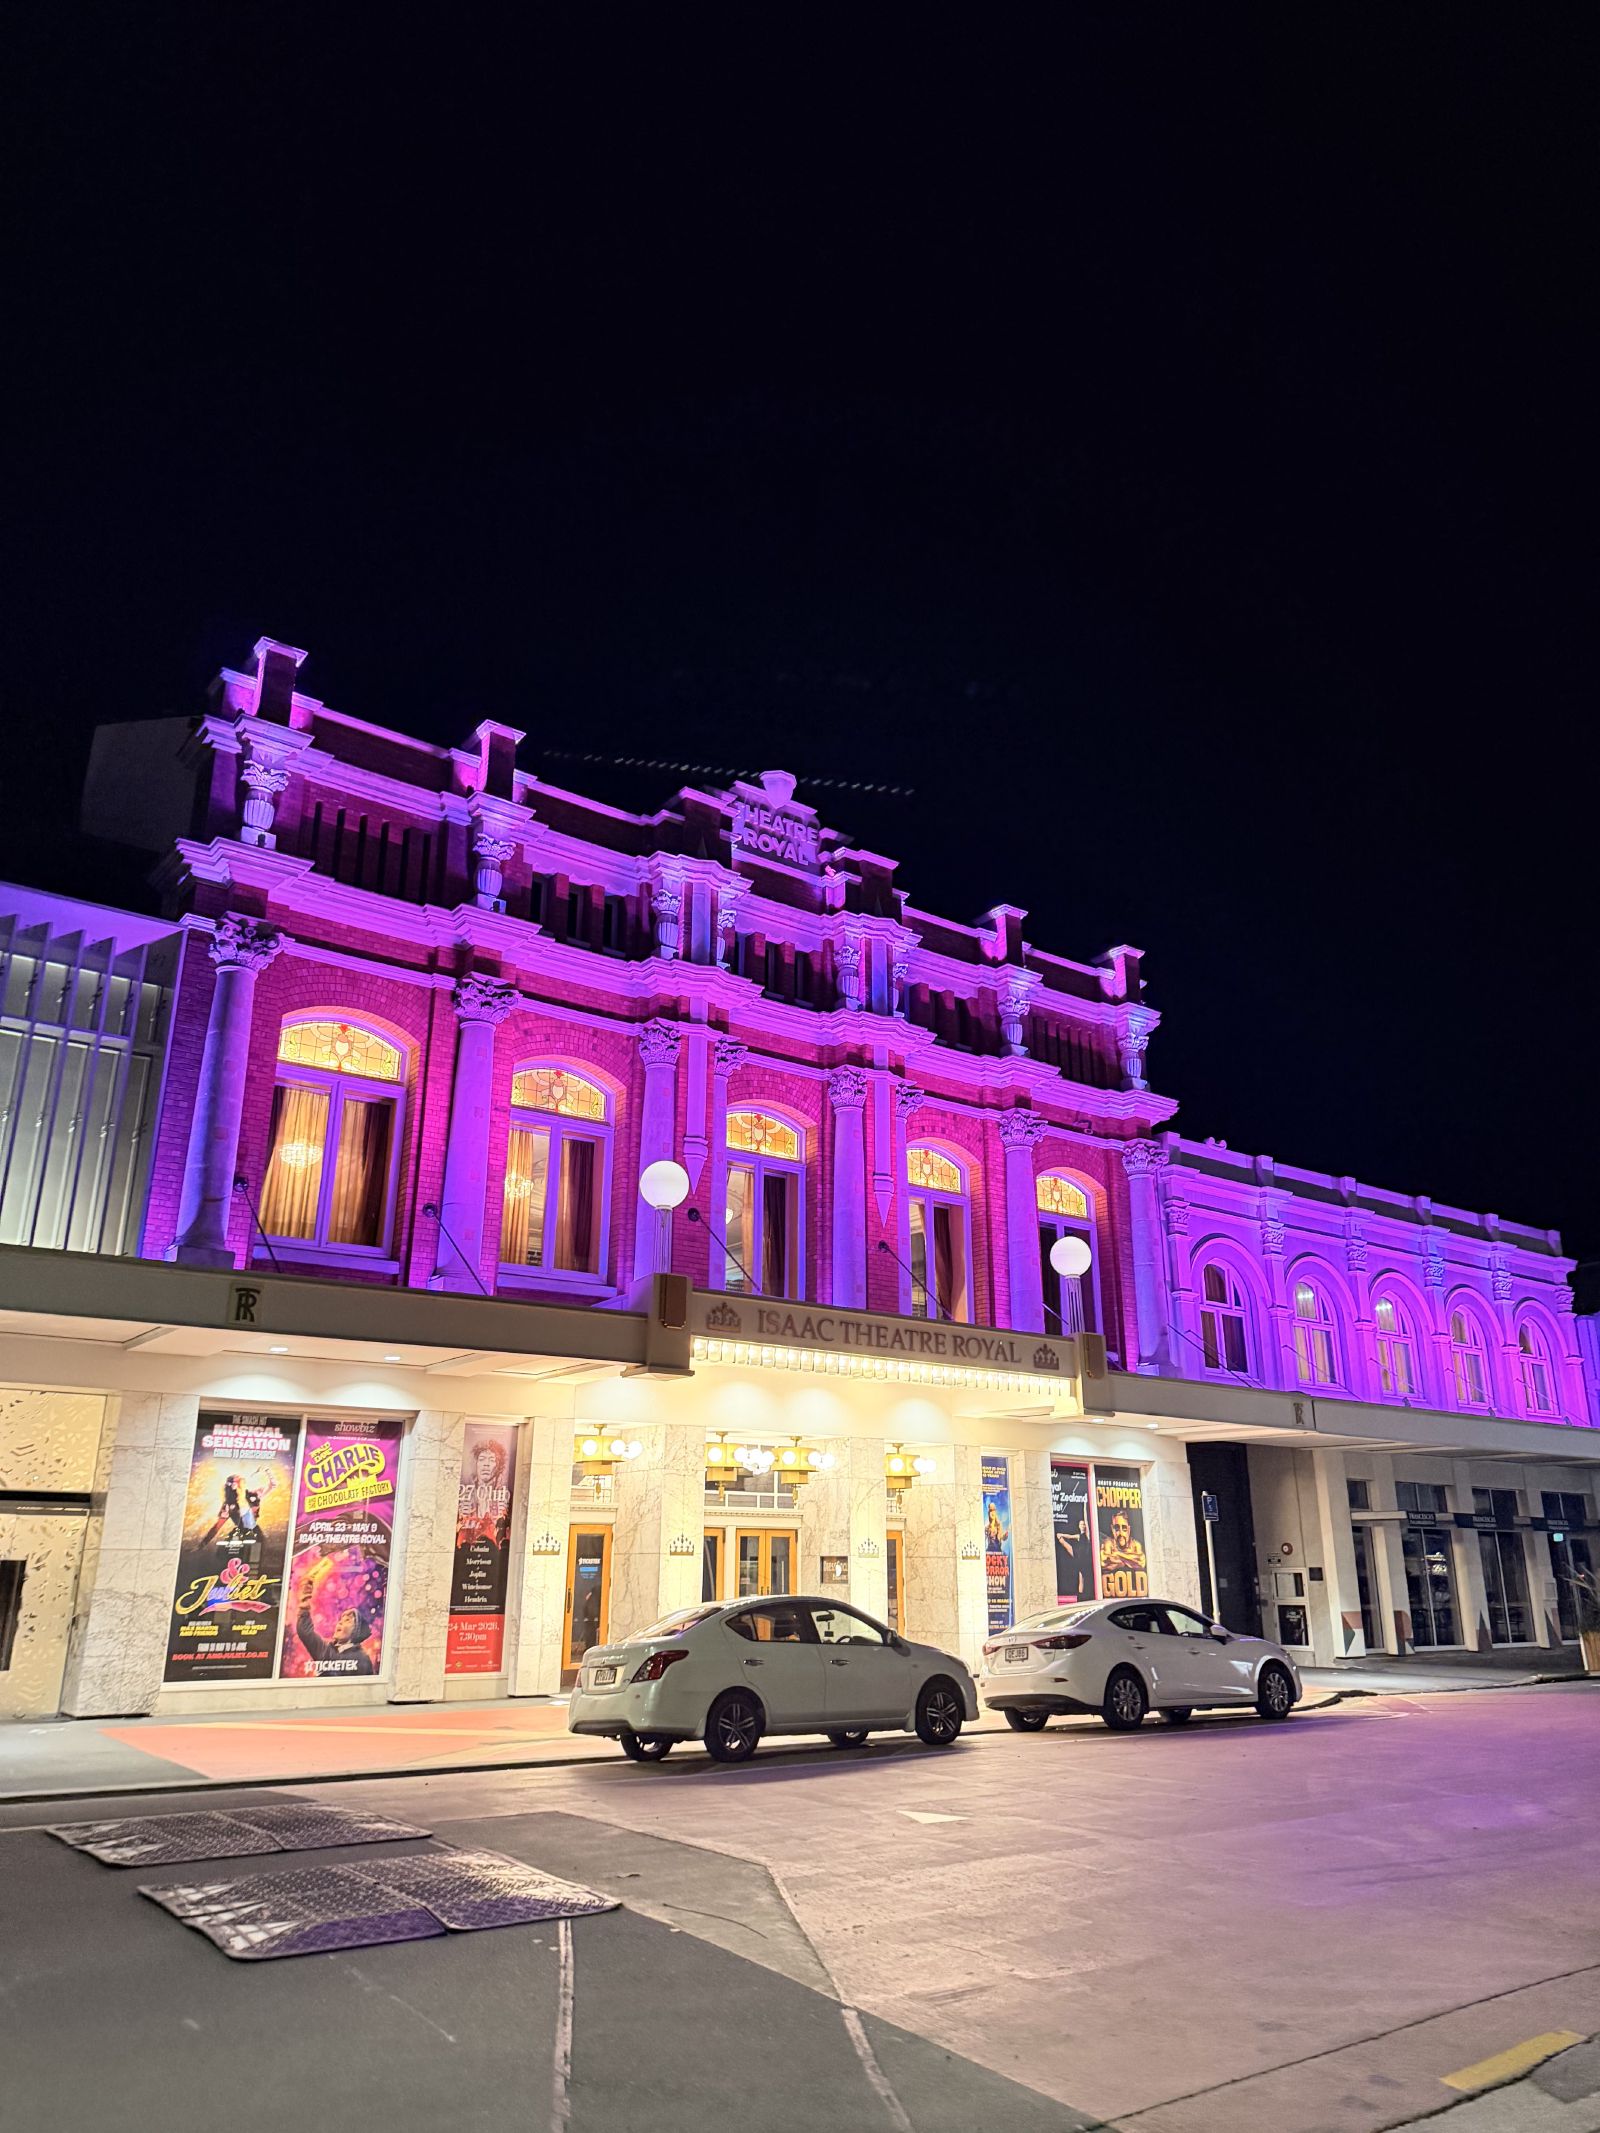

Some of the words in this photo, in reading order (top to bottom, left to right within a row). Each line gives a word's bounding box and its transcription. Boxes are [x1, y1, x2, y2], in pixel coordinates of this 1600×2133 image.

[735, 801, 819, 846] THEATRE
[743, 827, 809, 866] ROYAL
[757, 1309, 835, 1340] ISAAC
[840, 1321, 947, 1355] THEATRE
[952, 1335, 1022, 1364] ROYAL
[213, 1424, 283, 1438] MUSICAL
[335, 1422, 376, 1433] showbiz
[202, 1435, 291, 1451] SENSATION
[307, 1445, 380, 1489] CHARLIE
[317, 1487, 360, 1507] CHOCOLATE
[361, 1481, 390, 1498] FACTORY
[458, 1484, 475, 1500] 27
[477, 1485, 511, 1501] Club
[1060, 1492, 1088, 1503] Zealand
[1096, 1486, 1142, 1509] CHOPPER
[309, 1522, 333, 1533] APRIL
[334, 1522, 346, 1533] 23
[352, 1523, 370, 1533] MAY
[325, 1533, 360, 1544] THEATRE
[361, 1534, 387, 1544] ROYAL
[986, 1555, 1009, 1567] OCKY
[220, 1558, 251, 1585] &
[986, 1565, 1009, 1577] ORROR
[986, 1576, 1006, 1588] HOW
[1102, 1570, 1148, 1598] GOLD
[175, 1571, 281, 1615] Juliet
[459, 1621, 478, 1631] Mar
[315, 1659, 358, 1673] TICKETEK
